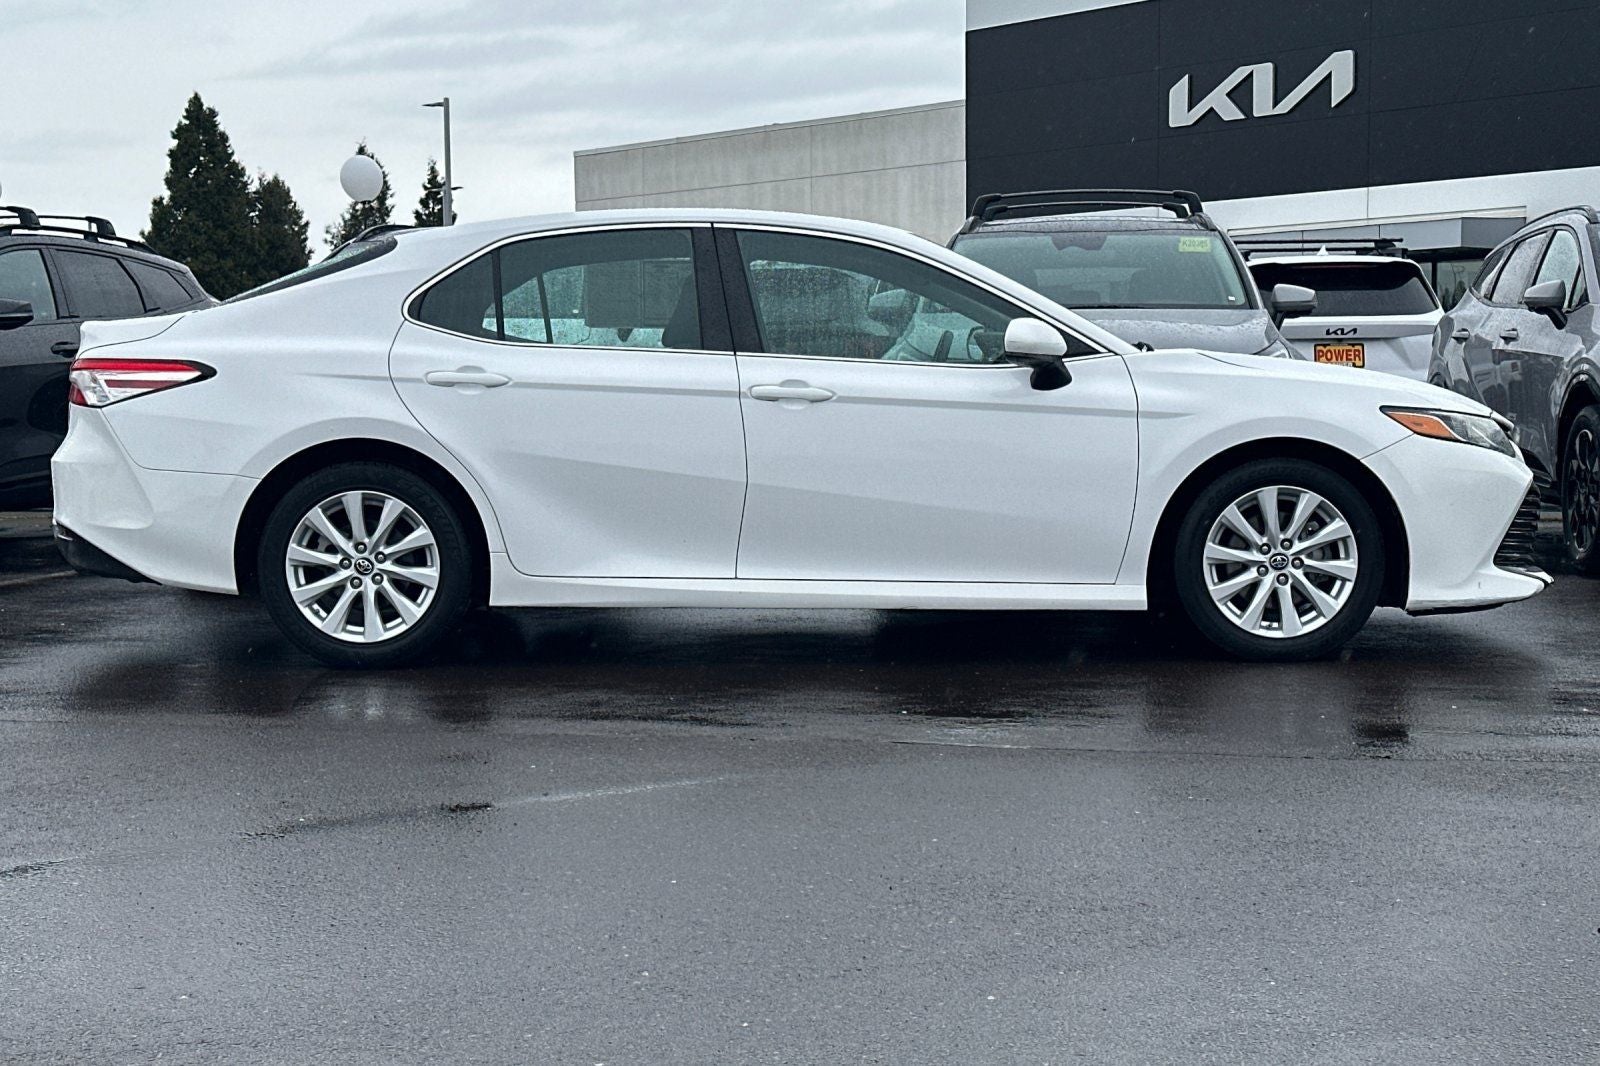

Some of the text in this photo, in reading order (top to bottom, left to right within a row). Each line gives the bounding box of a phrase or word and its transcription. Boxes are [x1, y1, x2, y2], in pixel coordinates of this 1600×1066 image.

[1168, 49, 1355, 128] KIA
[1325, 327, 1358, 336] KIA
[1317, 348, 1362, 362] POWER
